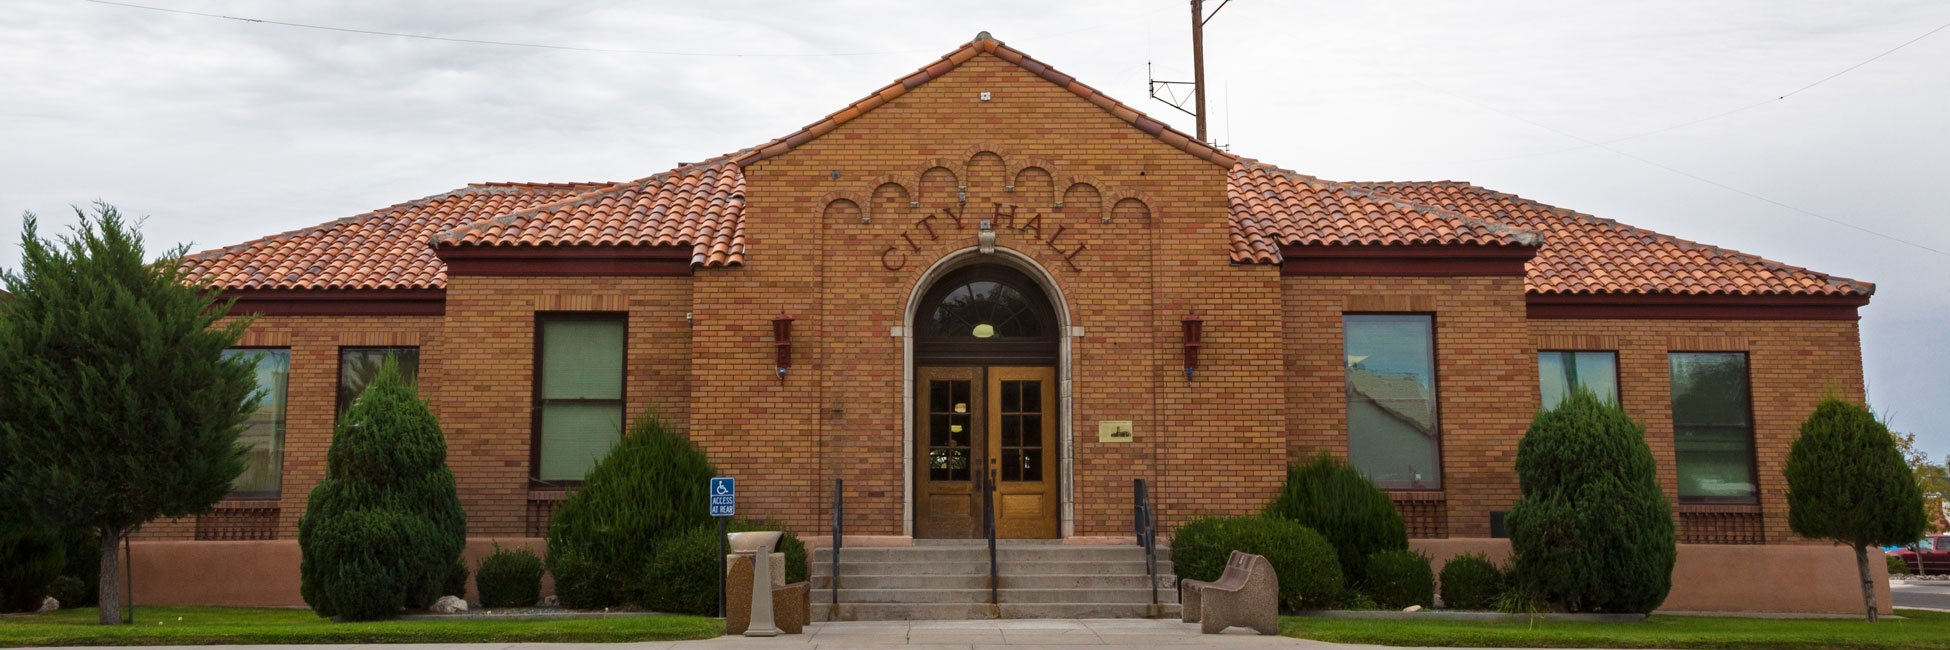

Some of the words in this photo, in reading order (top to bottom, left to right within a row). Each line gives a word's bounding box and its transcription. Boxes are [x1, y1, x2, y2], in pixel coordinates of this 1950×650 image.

[881, 202, 966, 271] CITY
[990, 202, 1087, 272] HALL
[712, 496, 732, 504] ACCESS
